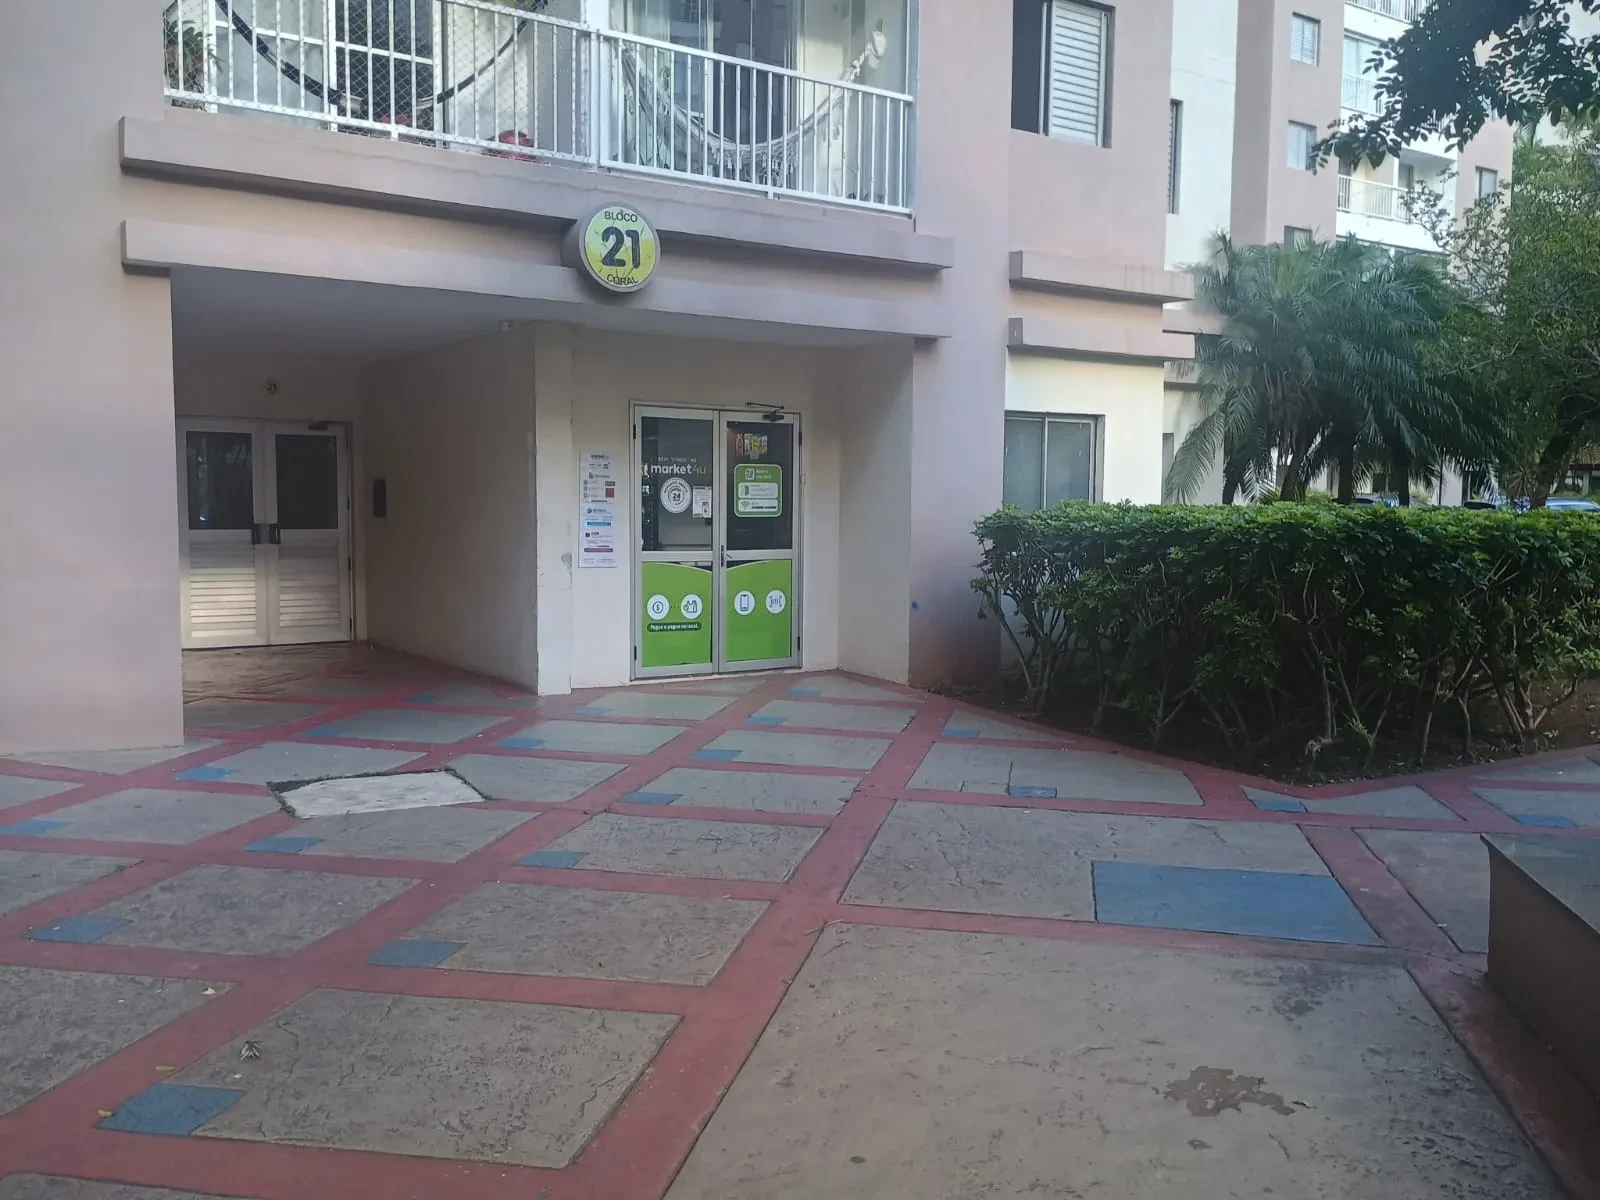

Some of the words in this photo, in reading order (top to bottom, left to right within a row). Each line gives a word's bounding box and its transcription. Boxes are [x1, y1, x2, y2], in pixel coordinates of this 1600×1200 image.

[604, 210, 638, 223] BLOCO
[601, 226, 641, 269] 21
[606, 273, 639, 285] CORAL
